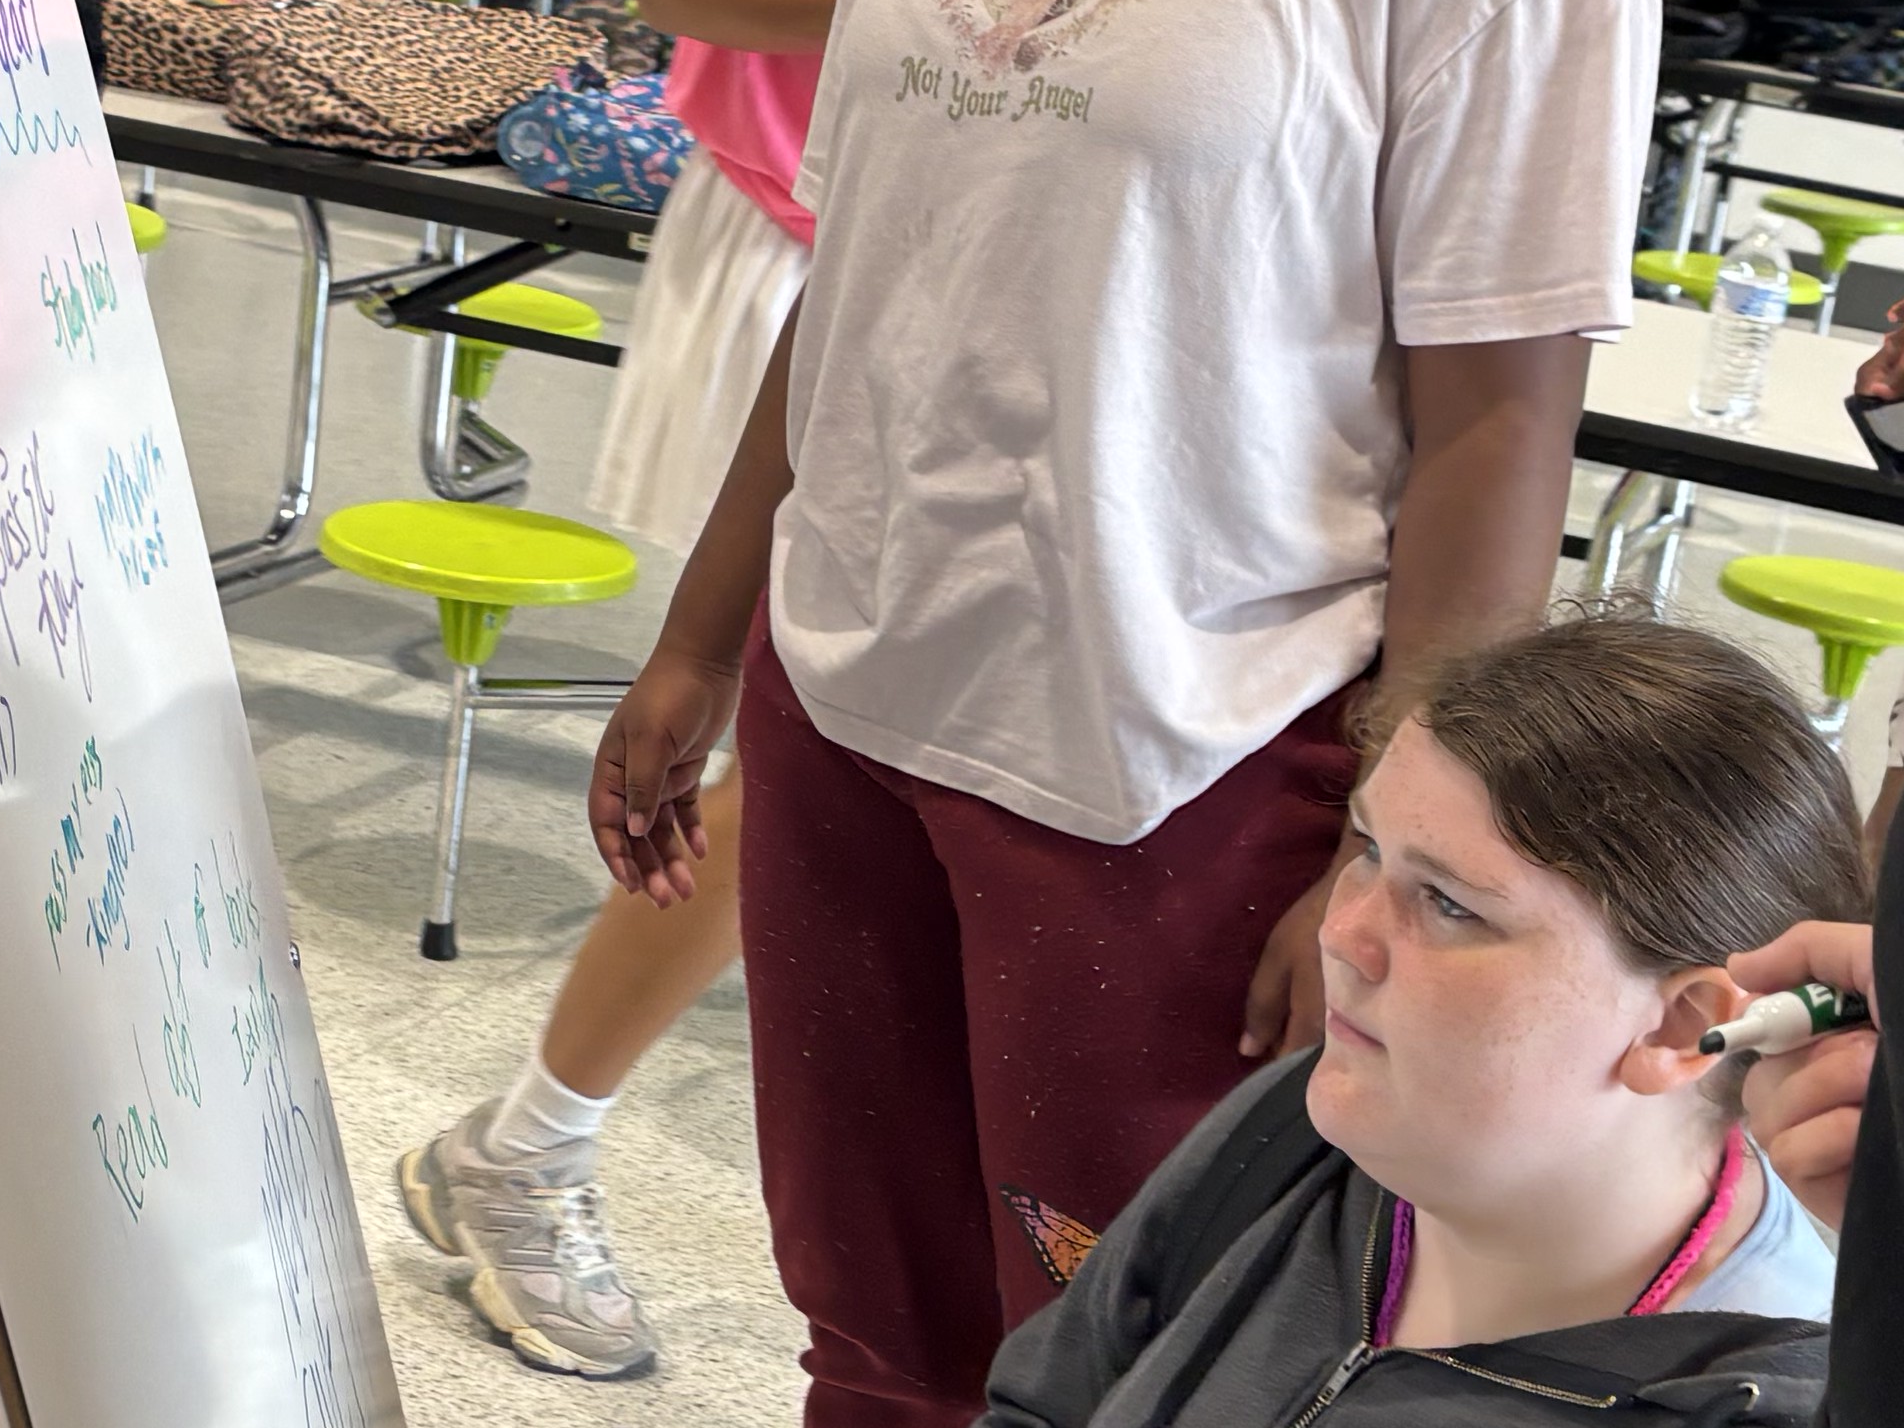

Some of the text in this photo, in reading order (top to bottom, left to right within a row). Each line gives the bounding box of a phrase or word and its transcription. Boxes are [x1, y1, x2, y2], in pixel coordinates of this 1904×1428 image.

[896, 55, 1094, 123] Not Your Angel
[92, 1023, 169, 1224] Read
